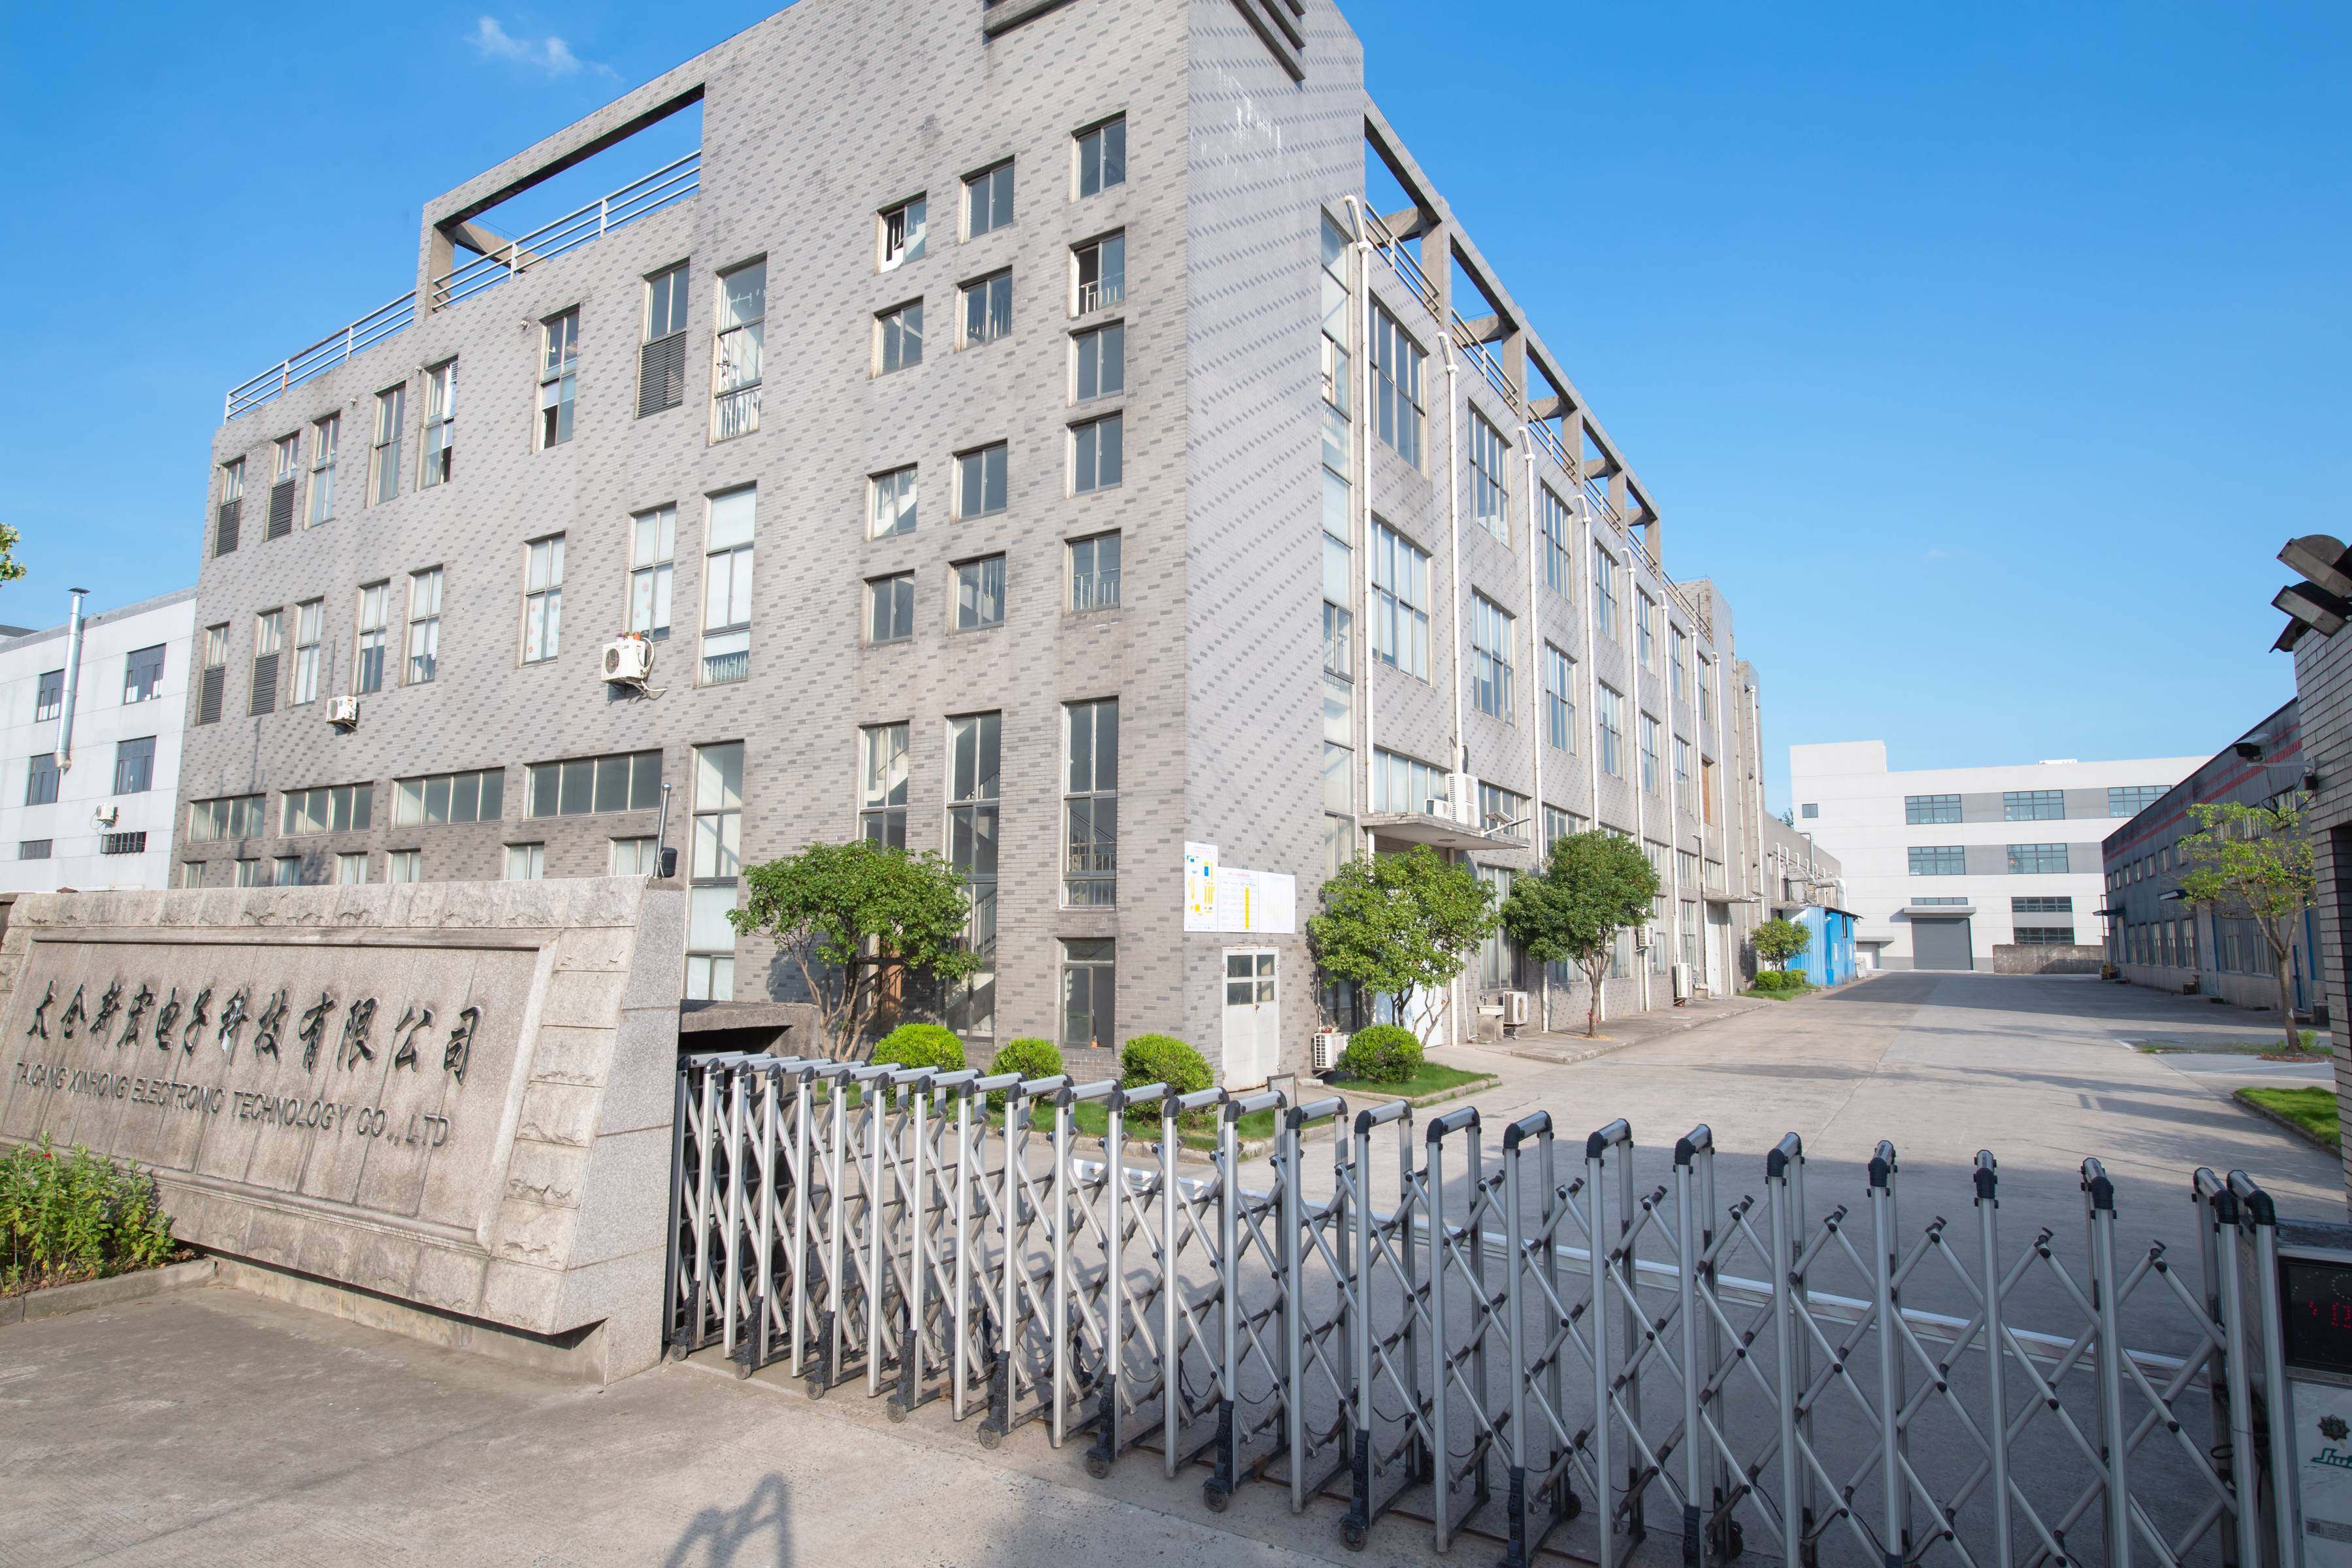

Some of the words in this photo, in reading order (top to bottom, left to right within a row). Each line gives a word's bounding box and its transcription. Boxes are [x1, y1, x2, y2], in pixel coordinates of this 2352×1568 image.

[26, 980, 482, 1086] 太仓新宏电子科技有限公司
[14, 1062, 68, 1089] TAICANG
[67, 1069, 129, 1099] XINHONG
[132, 1077, 226, 1113] ELECTRONIC
[231, 1090, 353, 1134] TECHNOLOGY
